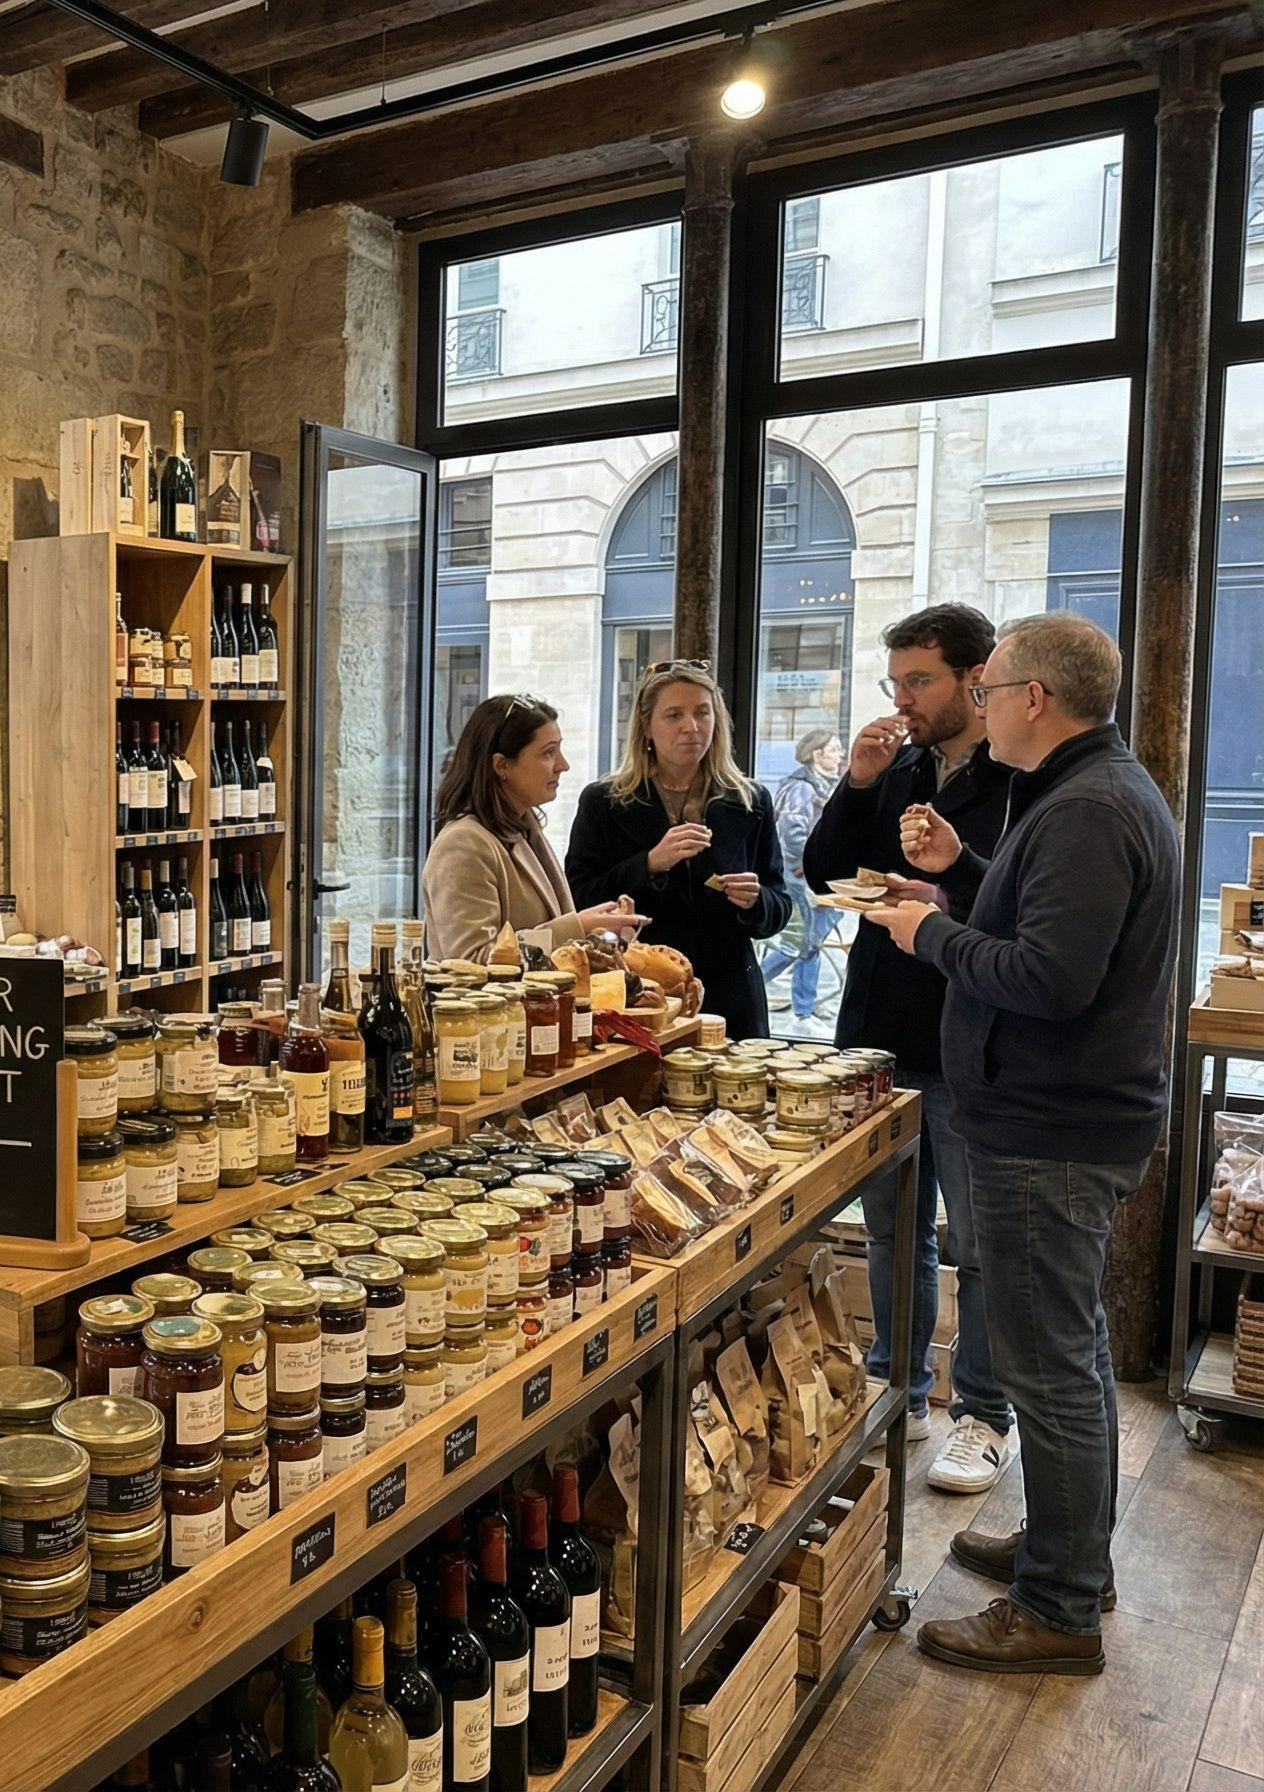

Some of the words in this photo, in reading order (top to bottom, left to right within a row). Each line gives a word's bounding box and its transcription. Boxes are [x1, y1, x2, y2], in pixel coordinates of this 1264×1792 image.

[0, 976, 14, 1012] R
[0, 1024, 50, 1060] NG
[0, 1069, 22, 1103] T
